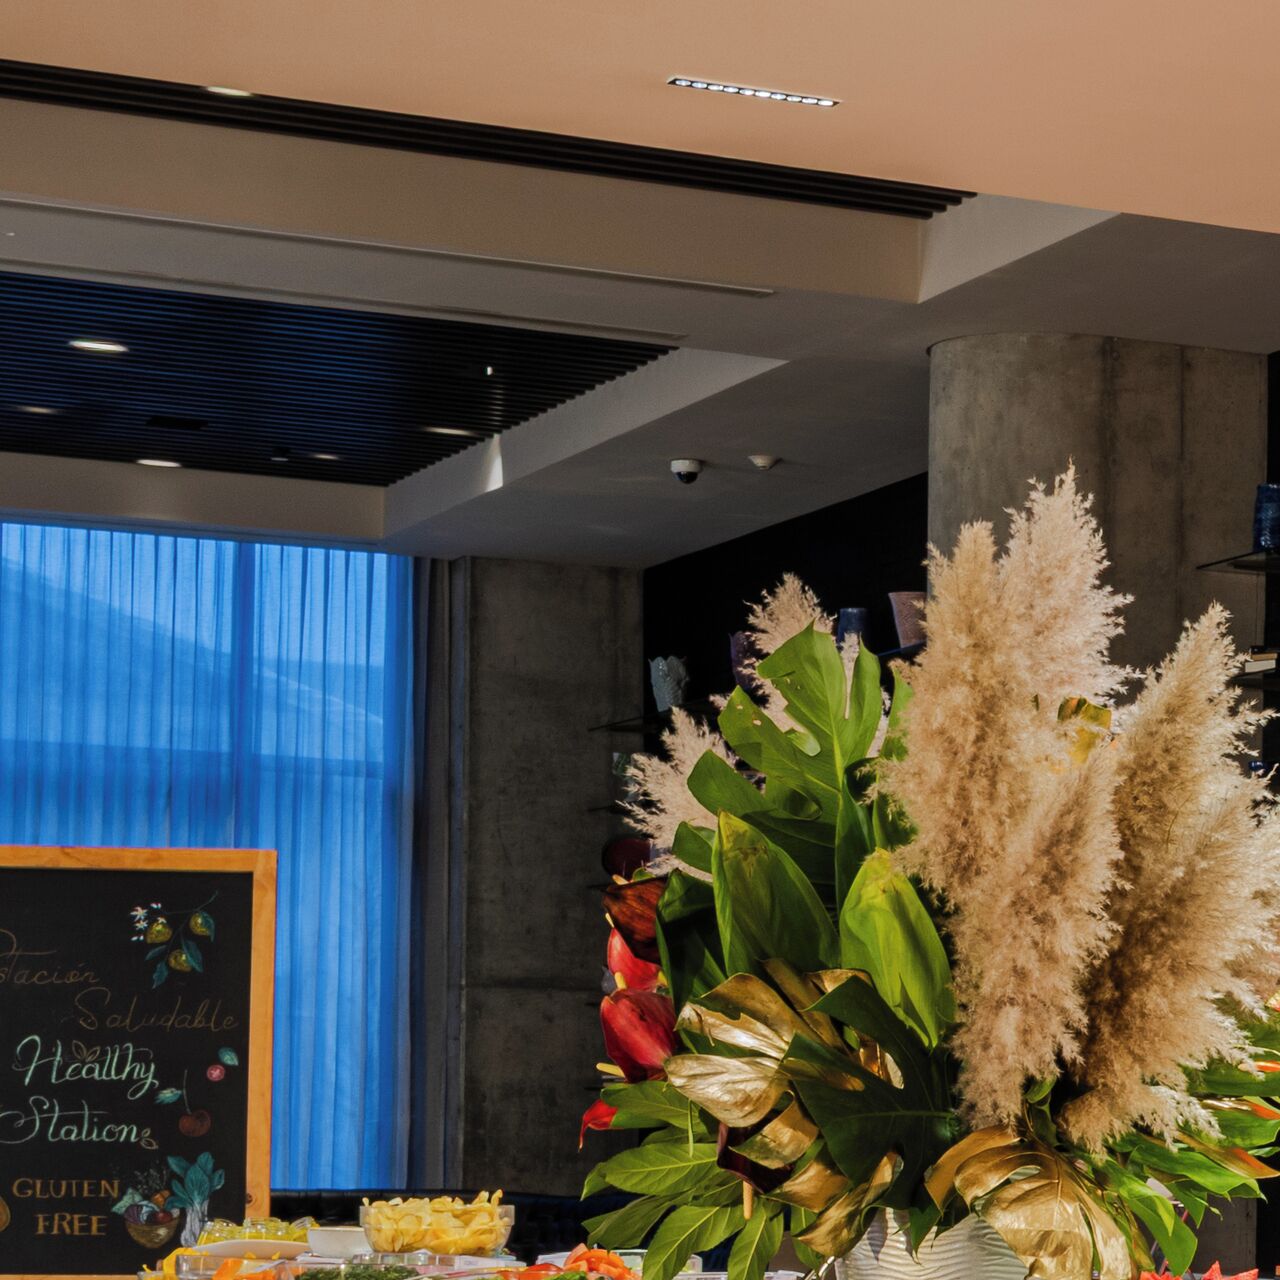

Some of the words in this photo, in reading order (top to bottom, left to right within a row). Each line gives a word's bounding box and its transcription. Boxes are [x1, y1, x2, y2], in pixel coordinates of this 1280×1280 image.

[74, 987, 240, 1032] Saludable
[12, 1035, 159, 1100] Healthy
[0, 1096, 141, 1144] Station
[12, 1178, 120, 1200] GLUTEN
[35, 1214, 108, 1237] FREE
